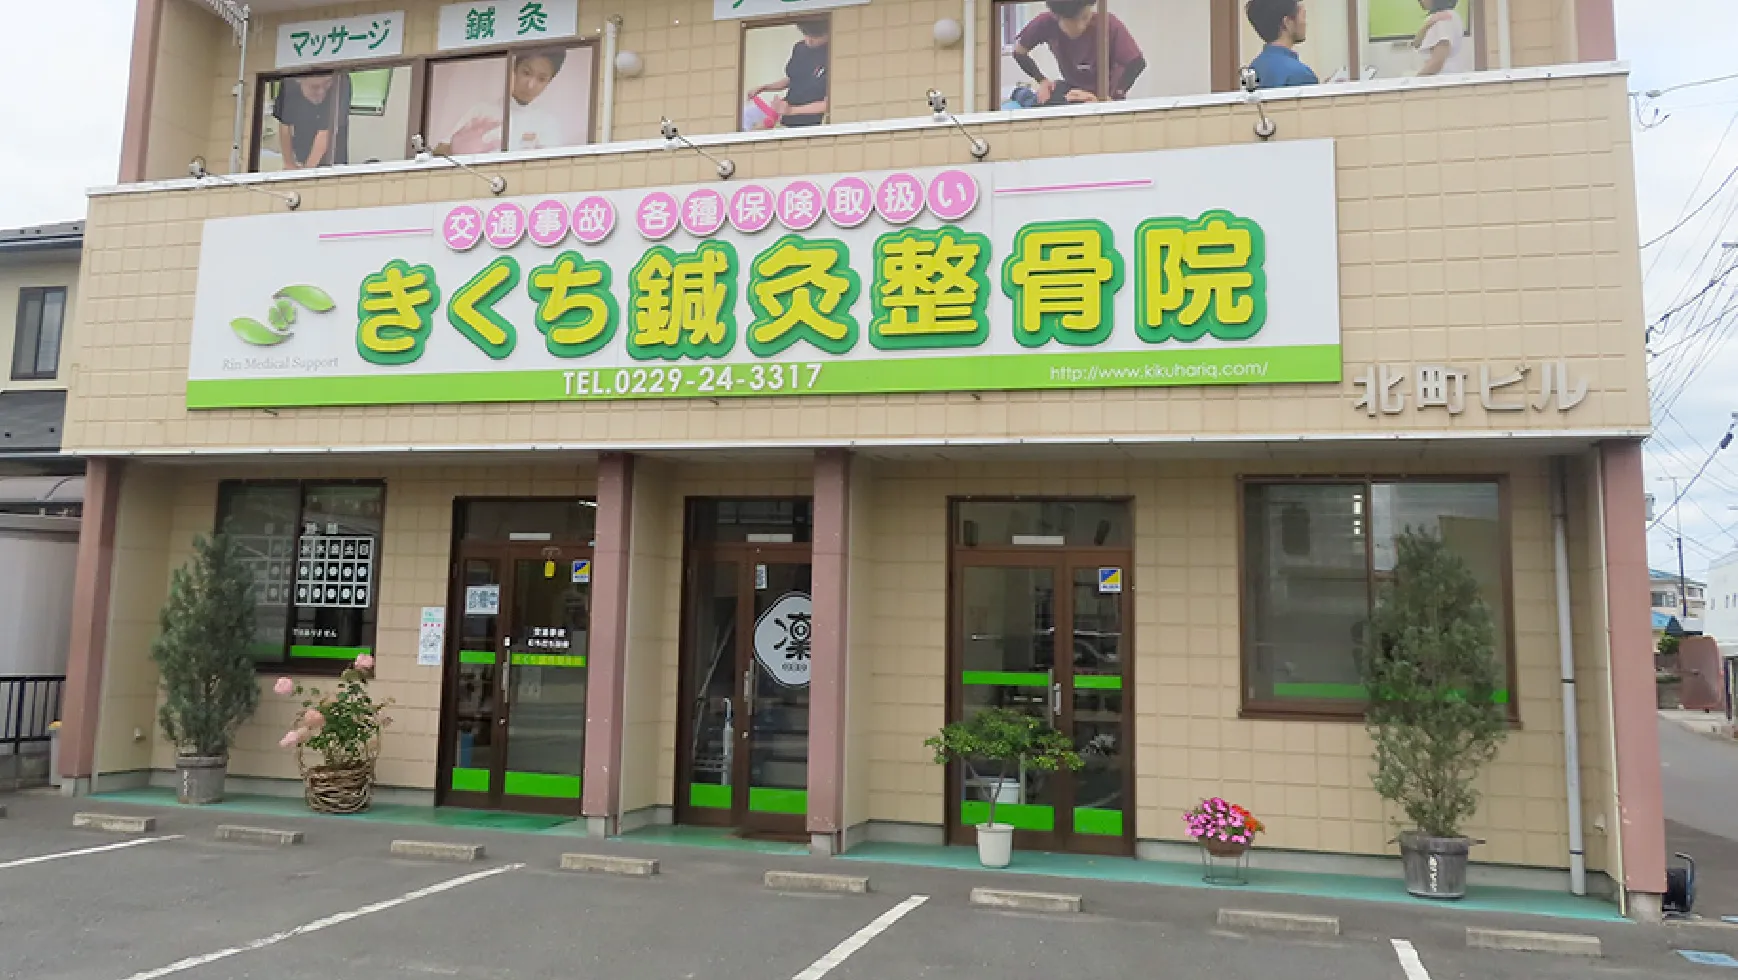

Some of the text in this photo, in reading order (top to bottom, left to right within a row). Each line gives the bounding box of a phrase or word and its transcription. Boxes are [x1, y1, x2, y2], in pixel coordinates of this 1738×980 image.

[290, 19, 391, 56] マッサージ
[465, 2, 548, 40] 鍼灸
[449, 179, 970, 243] 交通事故 各種保険取扱い
[356, 209, 1267, 366] きくち鍼灸整骨院
[223, 357, 339, 372] Rin Medical Support
[564, 364, 822, 395] TEL.0229-24-3317
[1354, 362, 1592, 418] 北町ビル
